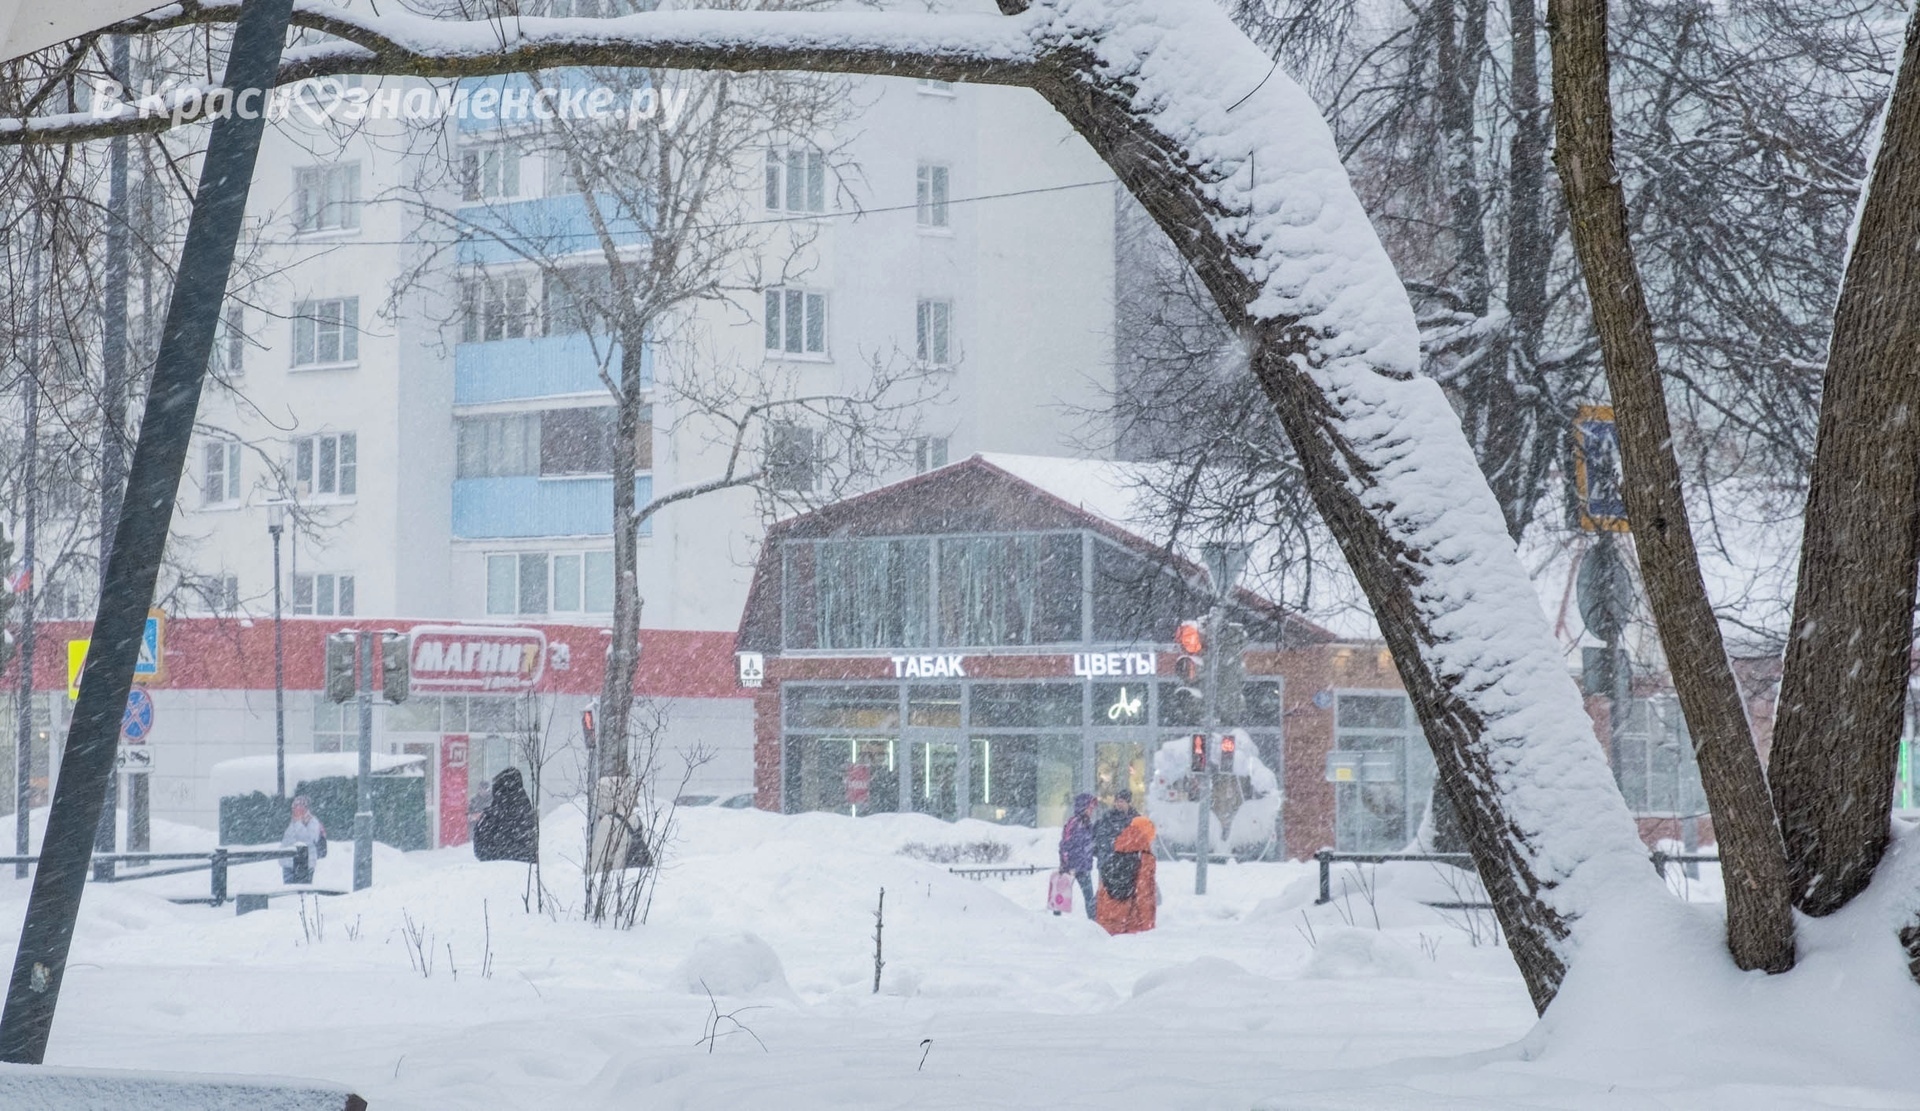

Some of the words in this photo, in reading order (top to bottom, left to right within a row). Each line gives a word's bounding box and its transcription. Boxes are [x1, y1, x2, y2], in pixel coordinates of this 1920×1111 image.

[414, 641, 539, 672] МАГНИТ
[892, 655, 967, 678] ТАБАК
[1074, 652, 1157, 680] ЦВЕТЫ
